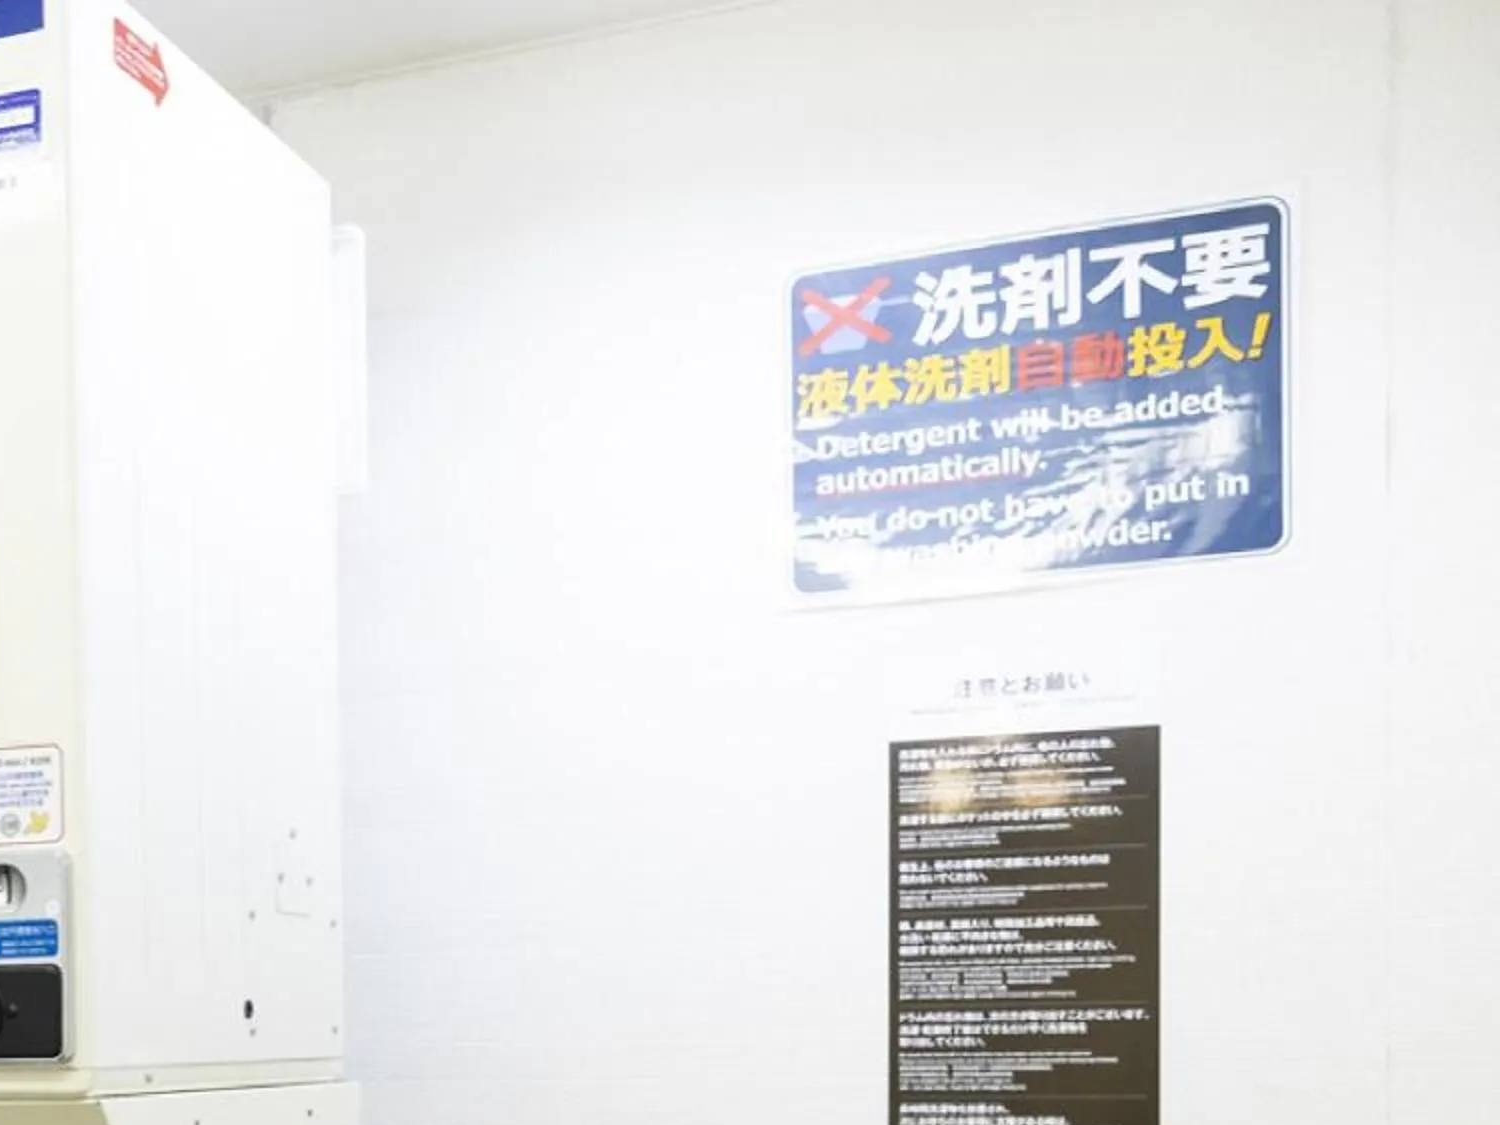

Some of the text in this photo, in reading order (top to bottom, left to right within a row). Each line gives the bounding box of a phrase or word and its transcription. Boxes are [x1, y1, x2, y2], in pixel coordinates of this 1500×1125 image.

[911, 223, 1272, 347] 洗剤不要
[816, 418, 982, 460] Detergent
[991, 407, 1050, 439] will
[1061, 403, 1103, 431] be
[816, 447, 1048, 495] automatically.
[887, 505, 925, 531] do
[937, 496, 996, 527] not
[1005, 493, 1088, 524] hav
[1145, 475, 1206, 511] put
[1217, 471, 1250, 499] in
[1049, 519, 1172, 556] owder.
